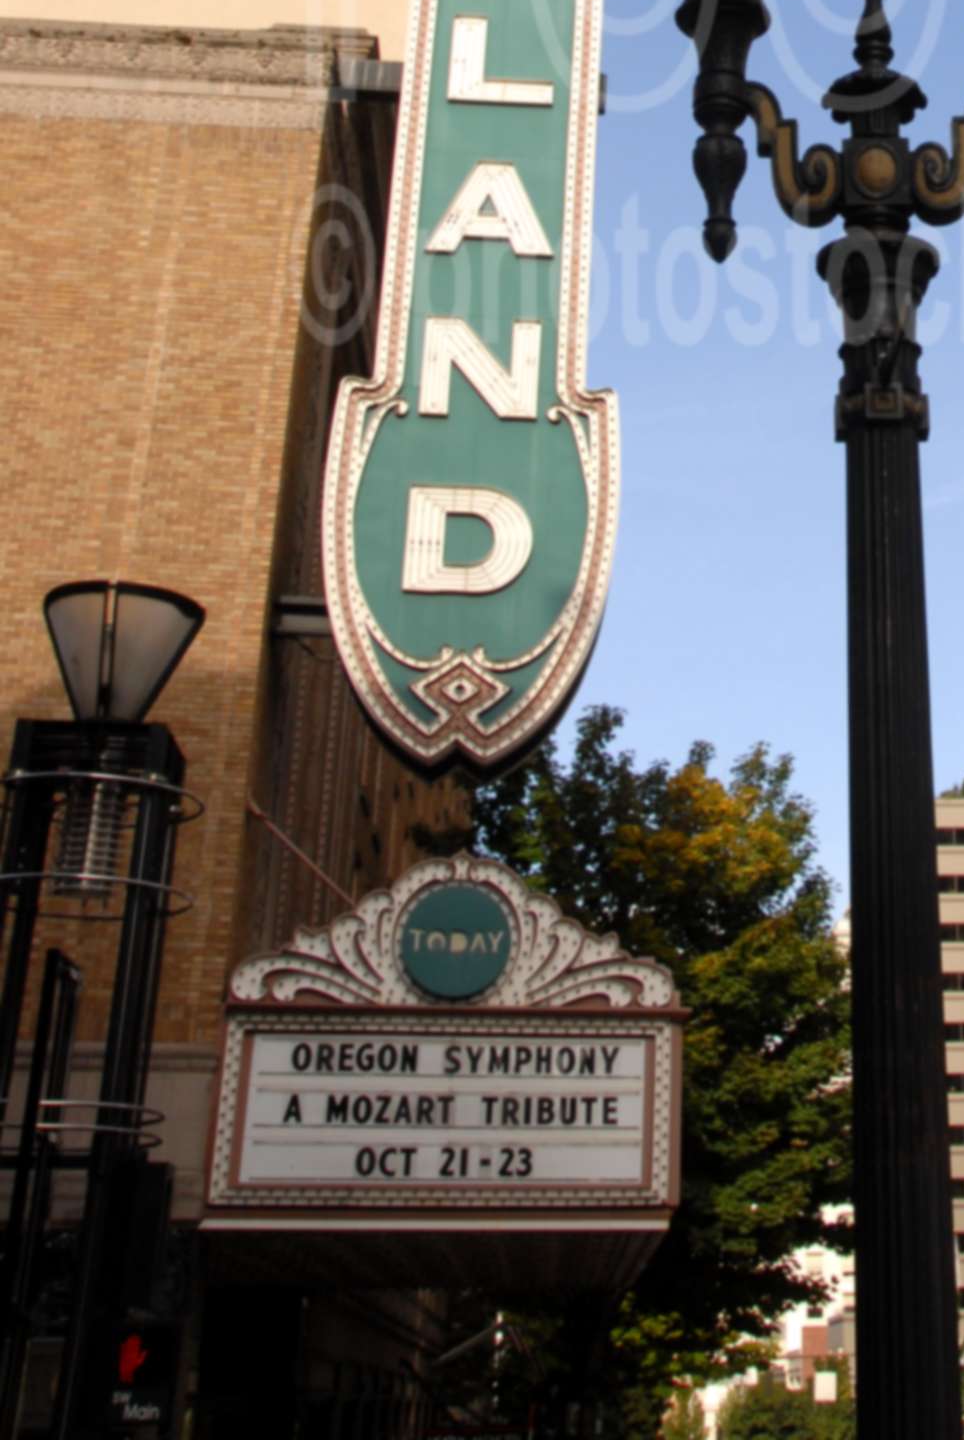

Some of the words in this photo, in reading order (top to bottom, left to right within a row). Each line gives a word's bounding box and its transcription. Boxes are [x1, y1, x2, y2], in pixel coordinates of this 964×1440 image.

[409, 927, 505, 955] TODAY
[291, 1042, 419, 1073] OREGON
[444, 1044, 621, 1076] SYMPHONY
[283, 1094, 302, 1124] A
[325, 1094, 456, 1125] MOZART
[481, 1095, 619, 1126] TRIBUTE
[354, 1147, 418, 1177] OCT
[122, 1403, 161, 1421] Main
